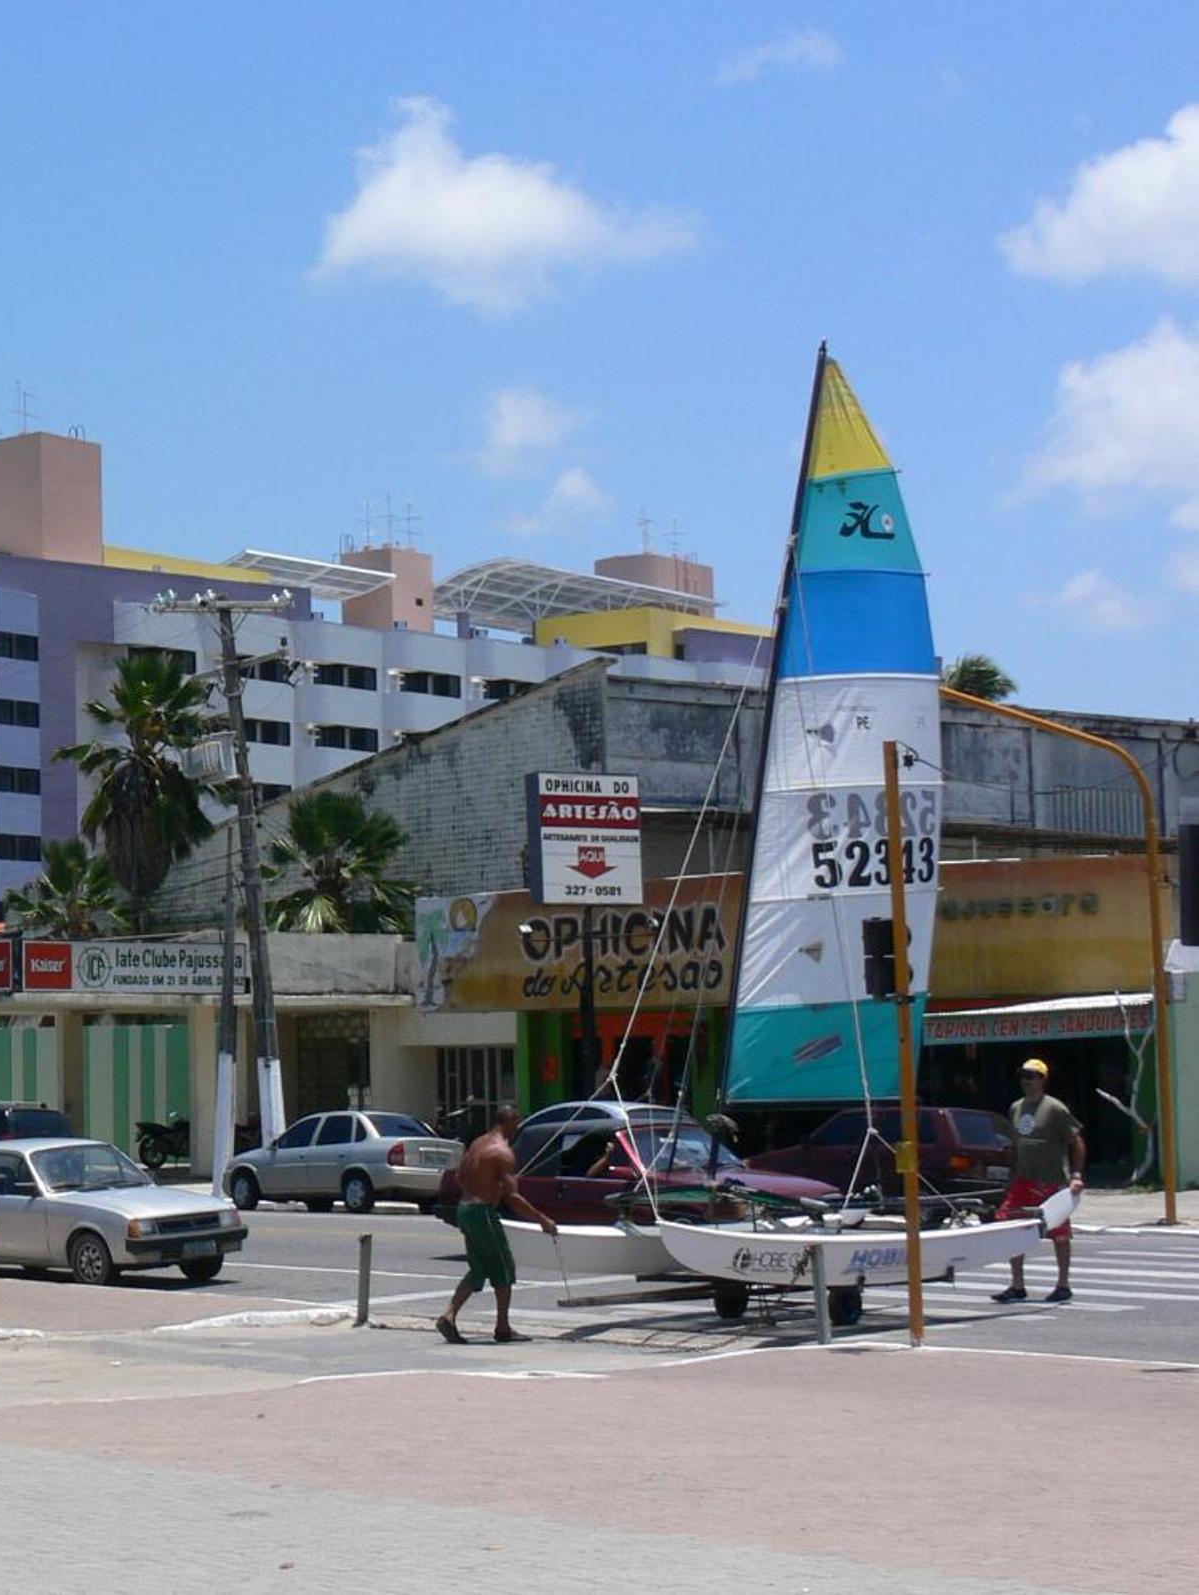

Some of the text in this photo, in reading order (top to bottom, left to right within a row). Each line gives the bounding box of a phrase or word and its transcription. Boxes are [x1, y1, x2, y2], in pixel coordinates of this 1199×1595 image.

[545, 779, 629, 794] OPHICINA DO
[543, 801, 637, 821] ARTESÃO
[580, 850, 605, 862] AQUI
[521, 906, 727, 962] OPHICINA
[30, 958, 64, 973] Kaiser
[115, 948, 140, 969] Iate
[142, 948, 176, 969] Clube
[523, 967, 556, 997] do
[991, 1015, 1049, 1036] CENTER
